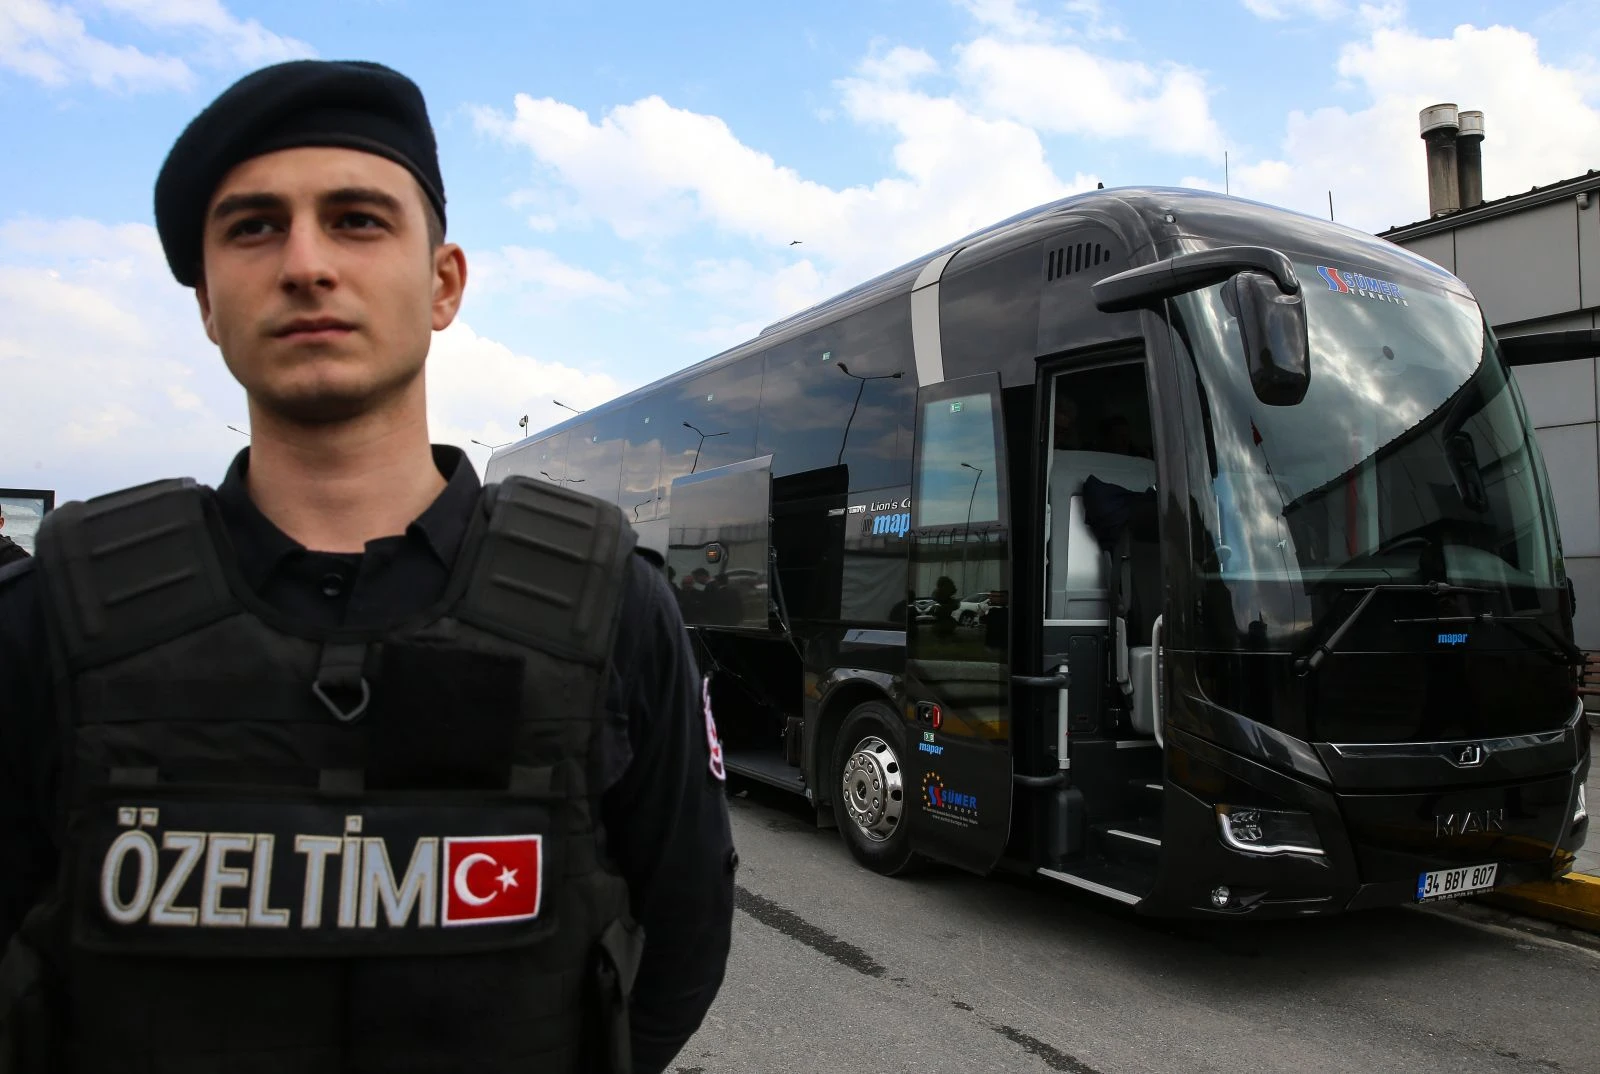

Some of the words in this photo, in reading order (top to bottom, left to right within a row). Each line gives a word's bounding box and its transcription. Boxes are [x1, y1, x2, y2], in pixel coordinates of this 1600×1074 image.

[1343, 271, 1405, 299] SÜMER
[870, 499, 898, 512] Lion's
[1438, 633, 1468, 646] mapar
[919, 742, 944, 755] mapar
[101, 806, 290, 928] ÖZEL
[294, 815, 440, 928] TİM
[1424, 874, 1440, 894] 34
[1444, 870, 1468, 891] BBY
[1472, 866, 1495, 887] 807
